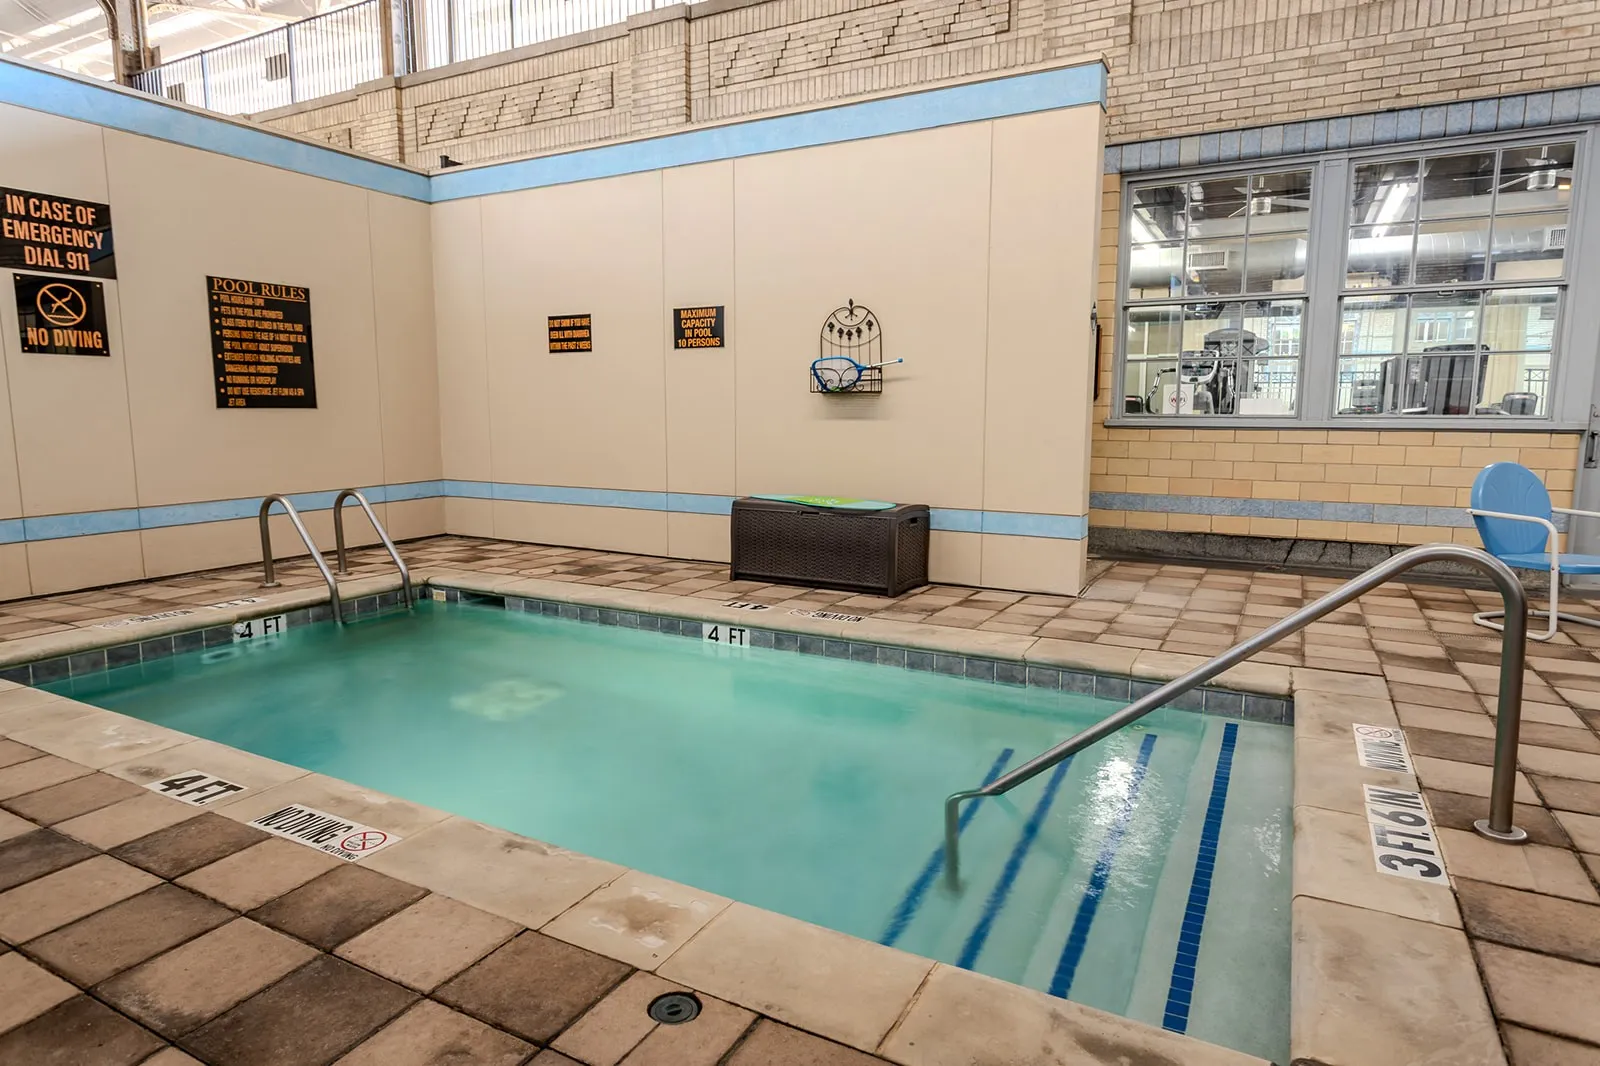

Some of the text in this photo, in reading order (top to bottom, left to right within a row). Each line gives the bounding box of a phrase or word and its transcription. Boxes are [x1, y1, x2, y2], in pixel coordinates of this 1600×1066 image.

[5, 194, 96, 226] IN CASE OF
[2, 218, 103, 250] EMERGENCY
[24, 246, 90, 271] DIAL 911
[212, 278, 306, 300] POOL RULES
[681, 308, 717, 318] MAXIMUM
[681, 318, 716, 328] CAPACITY
[27, 327, 103, 348] NO DIVING
[678, 337, 721, 347] 10 PERSONS
[685, 328, 713, 337] IN POOL
[239, 615, 281, 639] 4 FT
[708, 625, 746, 646] 4 FT
[253, 806, 354, 844] NO DIVING
[1379, 854, 1442, 878] 3
